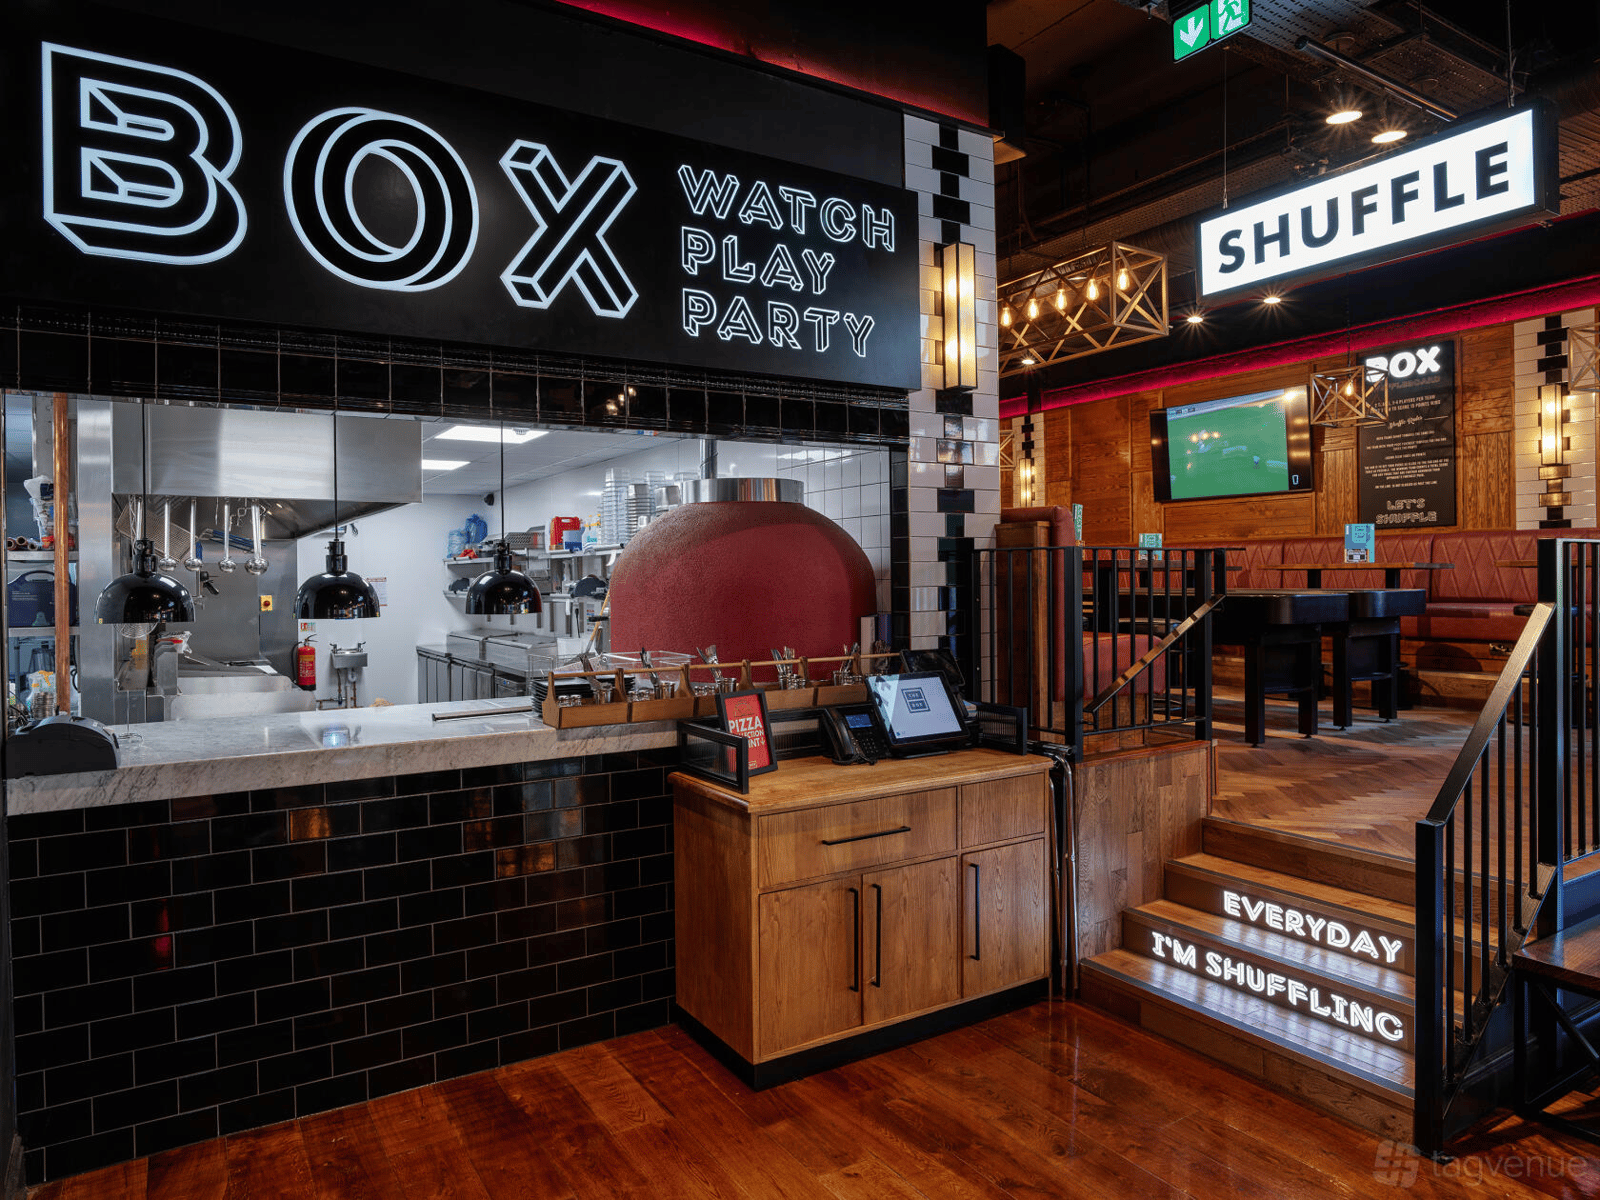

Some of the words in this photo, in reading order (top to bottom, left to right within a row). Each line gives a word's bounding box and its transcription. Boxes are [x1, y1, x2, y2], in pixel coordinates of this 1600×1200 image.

[42, 41, 638, 318] BOX
[677, 164, 895, 252] WATCH
[1218, 141, 1509, 274] SHUFFLE
[681, 226, 835, 295] PLAY
[682, 287, 875, 357] PARTY
[1366, 346, 1440, 382] BOX
[1375, 511, 1437, 524] SHUFFLE
[1386, 498, 1426, 510] LET'S
[729, 716, 762, 733] PIZZA
[1223, 890, 1403, 964] EVERYDAY
[1151, 931, 1197, 970] I'M
[1205, 951, 1404, 1042] SHUFFLING
